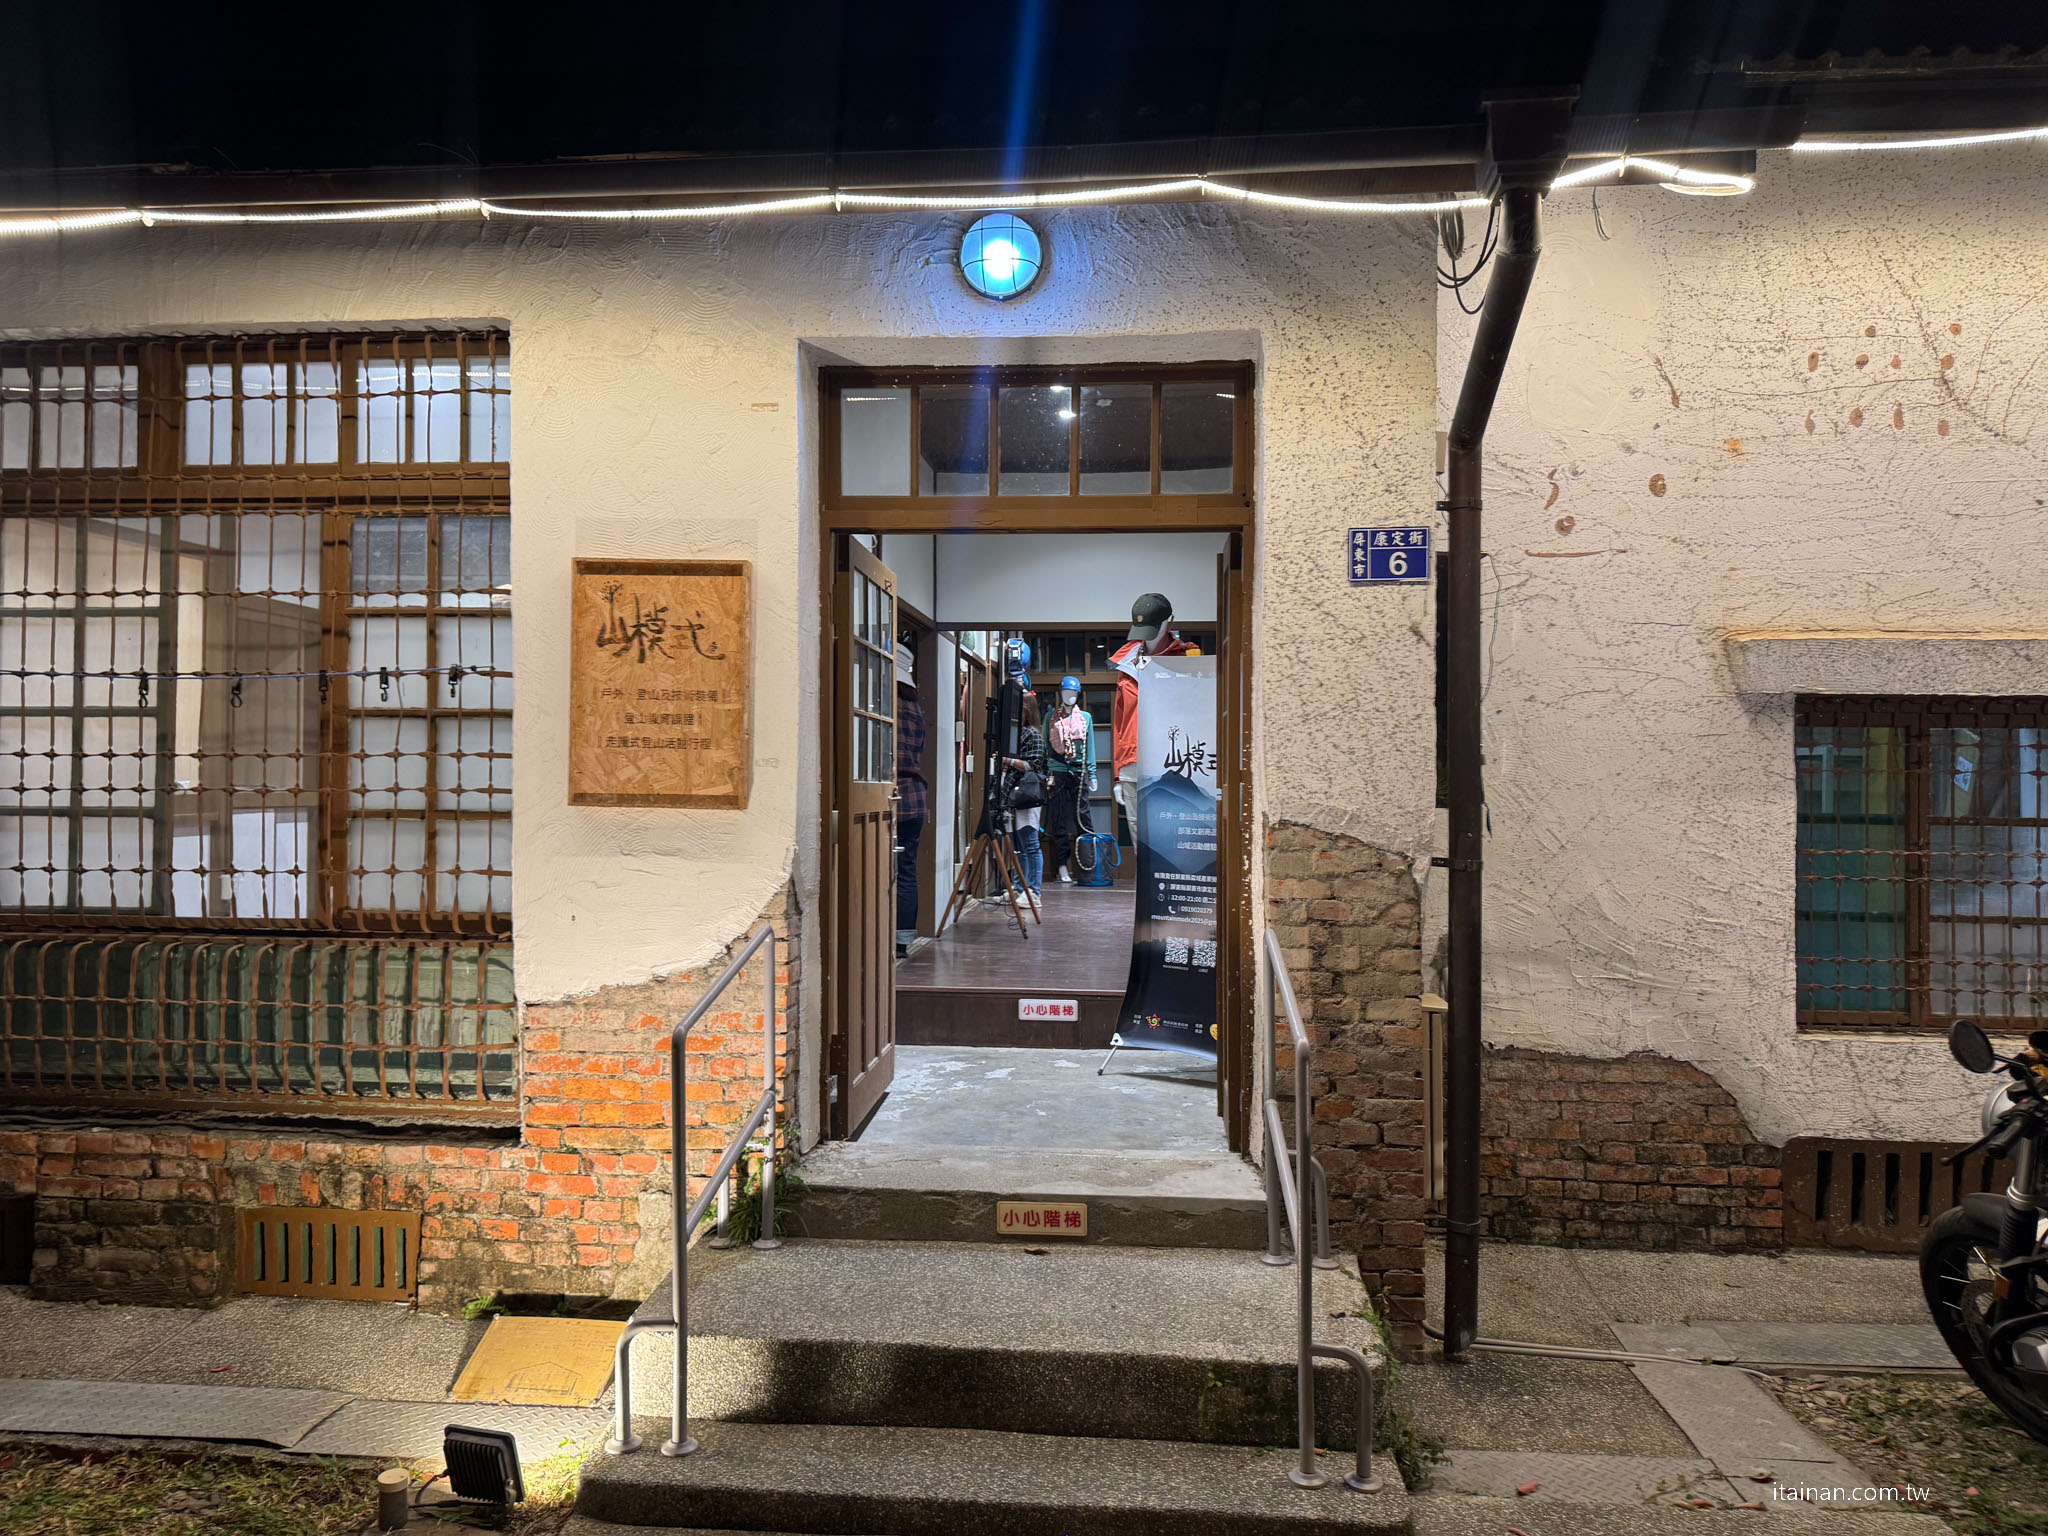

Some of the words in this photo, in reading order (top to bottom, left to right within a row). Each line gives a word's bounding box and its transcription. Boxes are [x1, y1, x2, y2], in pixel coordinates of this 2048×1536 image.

[1373, 531, 1424, 546] 康定街
[1353, 532, 1366, 577] 屏東市
[1388, 551, 1408, 576] 6
[596, 580, 725, 664] 山模式
[1023, 1004, 1074, 1016] 小心階梯
[1003, 1209, 1082, 1229] 小心階梯
